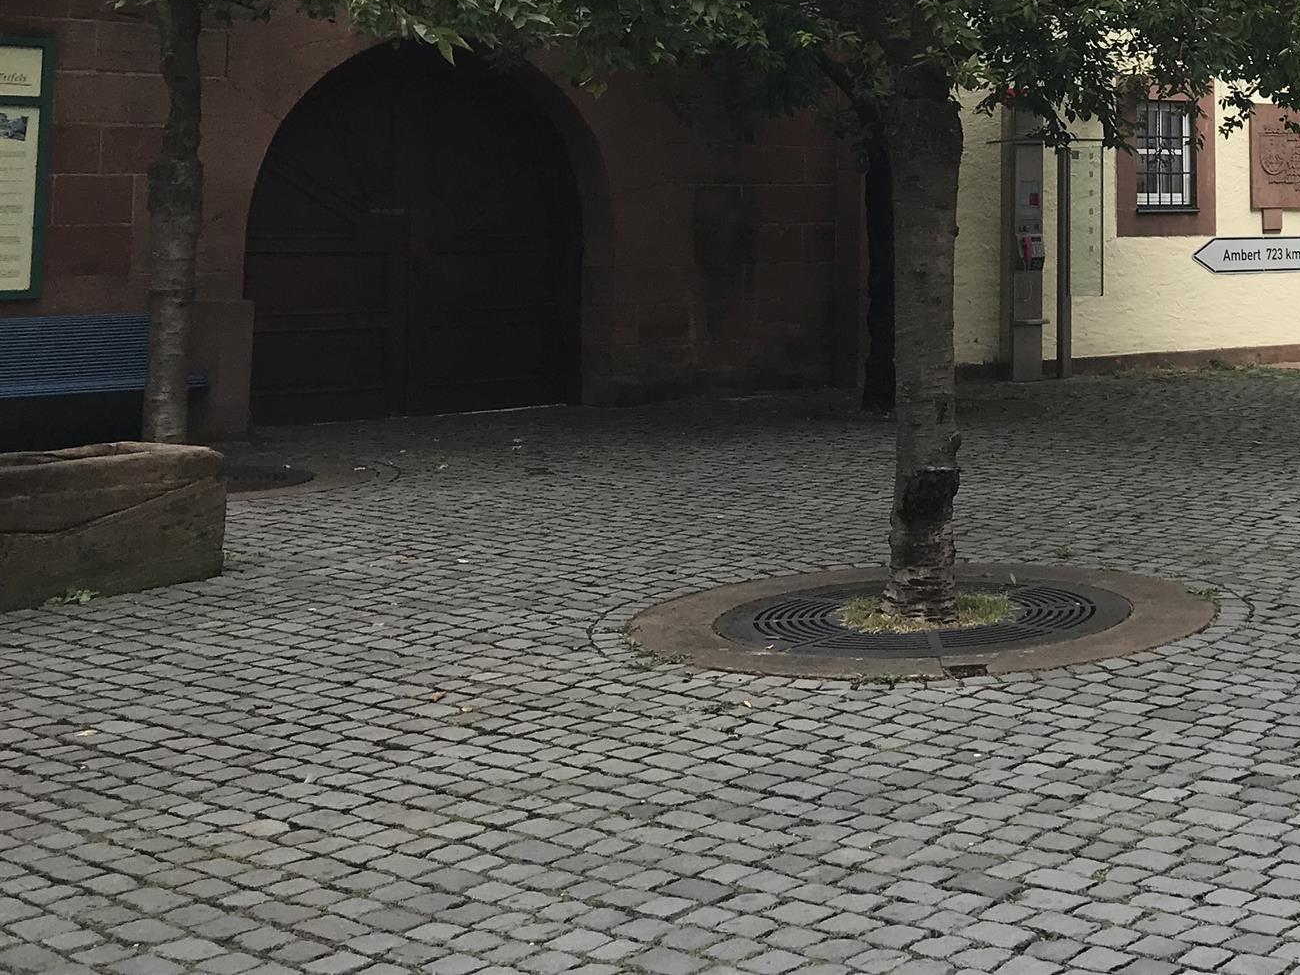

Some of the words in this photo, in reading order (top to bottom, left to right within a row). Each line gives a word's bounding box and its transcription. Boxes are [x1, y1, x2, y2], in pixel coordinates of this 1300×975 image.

[1222, 249, 1261, 261] Ambert
[1266, 248, 1283, 260] 723
[1286, 247, 1300, 260] km
